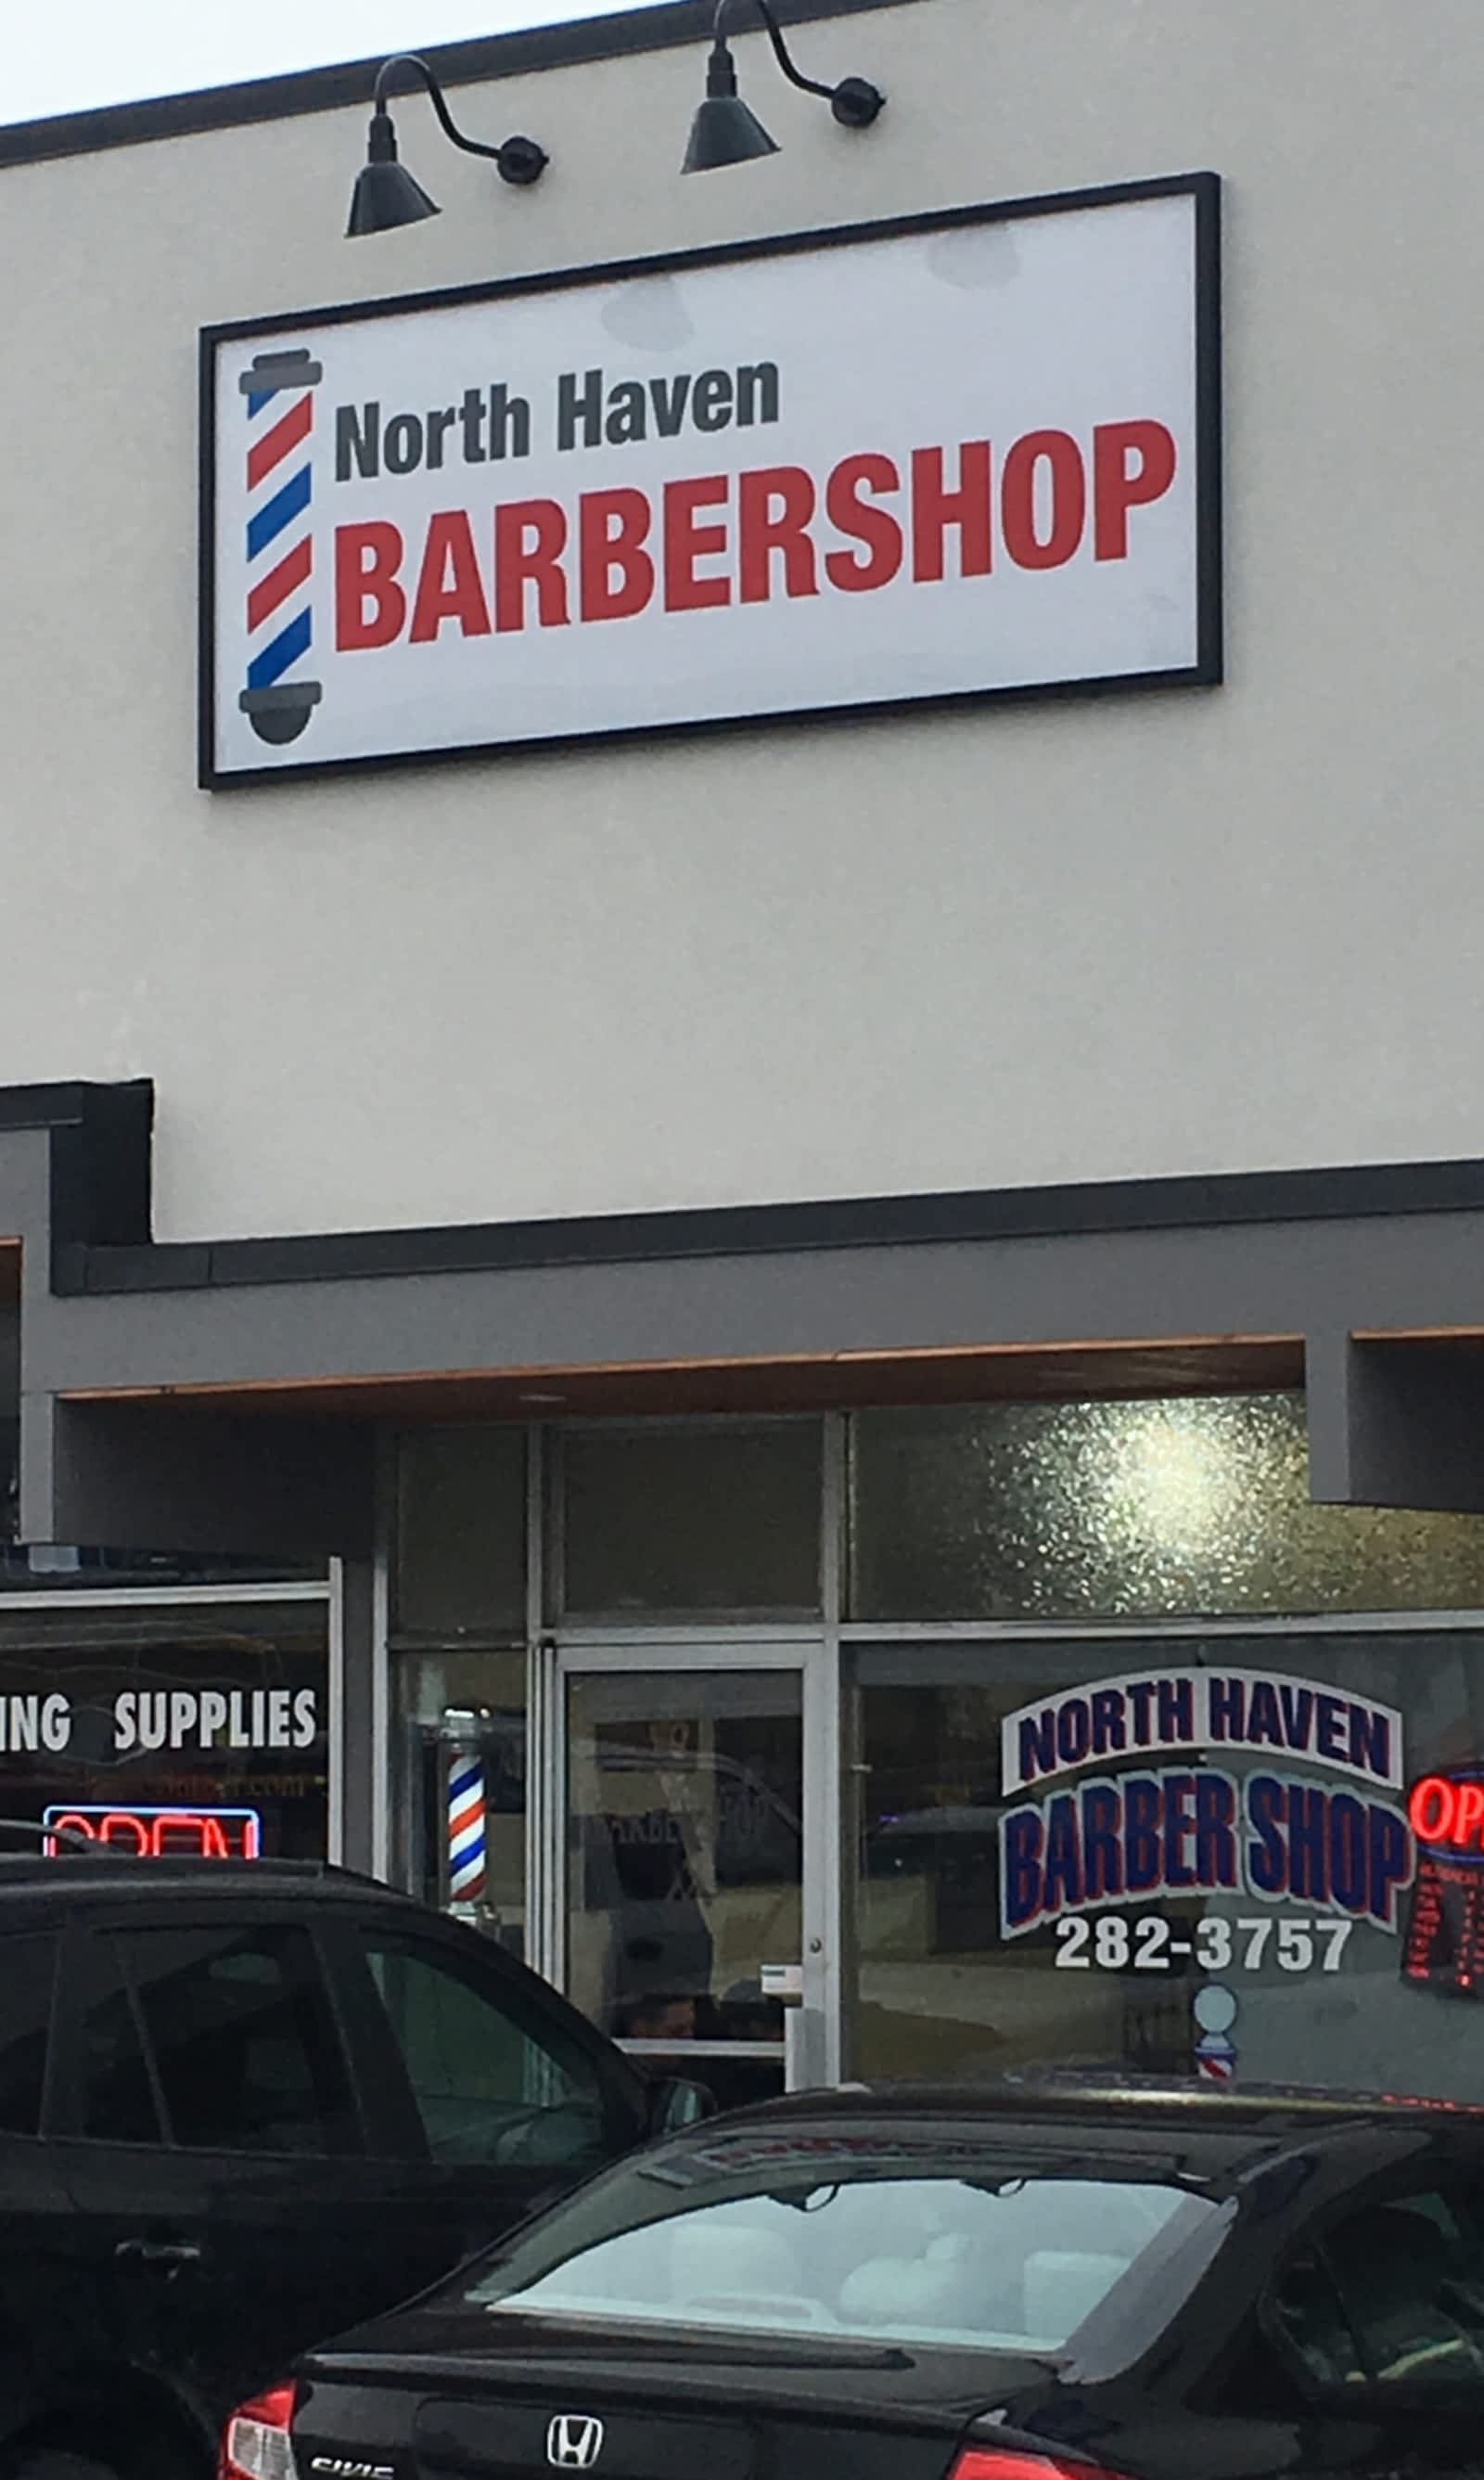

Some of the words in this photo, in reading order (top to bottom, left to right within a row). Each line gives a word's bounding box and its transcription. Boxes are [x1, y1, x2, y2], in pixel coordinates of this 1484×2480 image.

[335, 381, 531, 483] North
[557, 361, 779, 452] Haven
[337, 420, 1176, 649] BARBERSHOP
[114, 1689, 316, 1750] SUPPLIES
[1019, 1678, 1195, 1782] NORTH
[1209, 1676, 1391, 1780] HAVEN
[1004, 1771, 1239, 1931] BARBER
[1245, 1773, 1414, 1926] SHOP
[1408, 1776, 1484, 1852] OP
[1055, 1916, 1353, 1972] 282-3757
[311, 2456, 395, 2480] CIVIC
